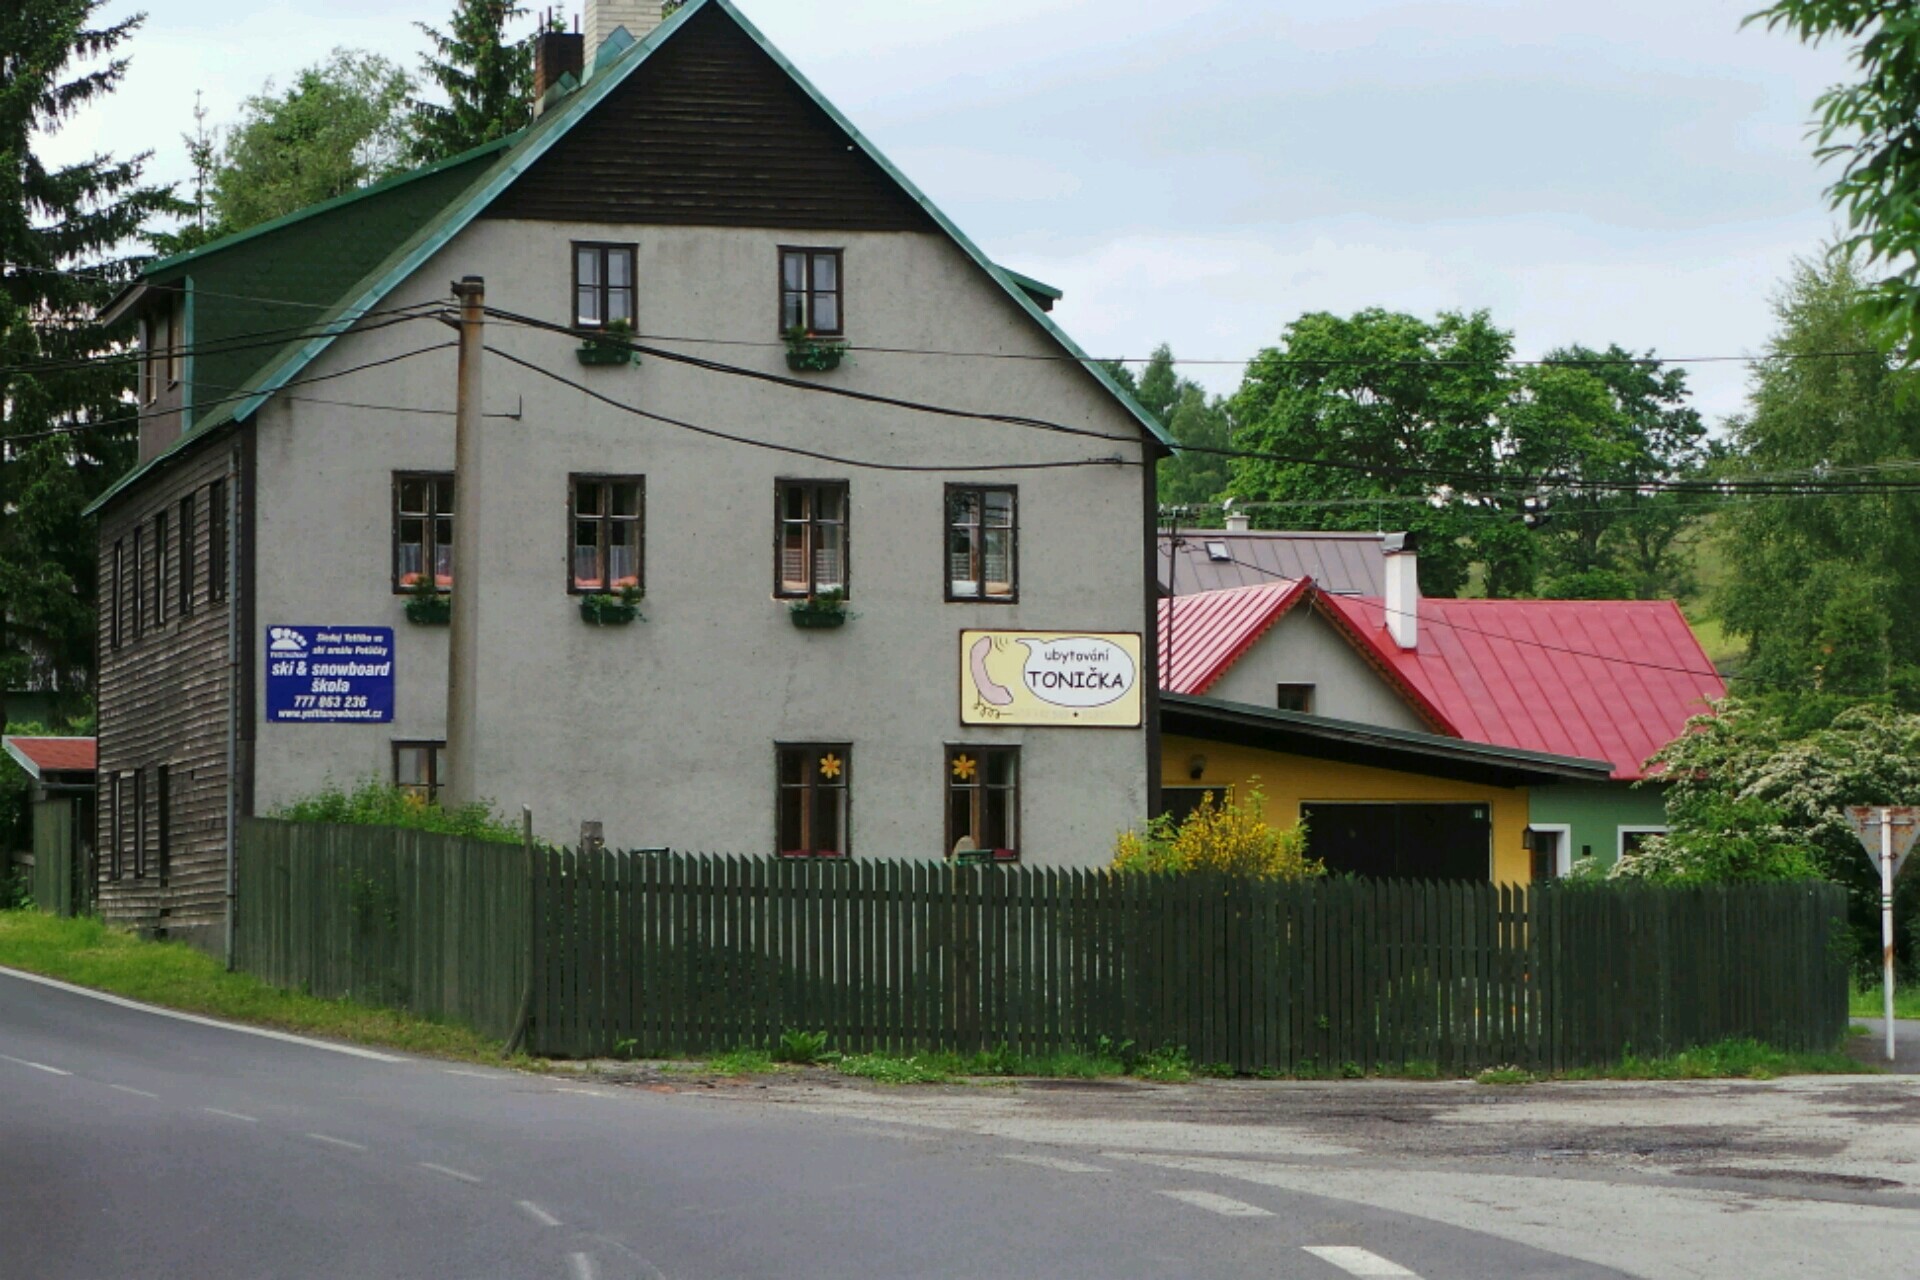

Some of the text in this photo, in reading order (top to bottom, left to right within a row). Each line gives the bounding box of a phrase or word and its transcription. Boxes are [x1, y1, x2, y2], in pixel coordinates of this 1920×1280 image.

[312, 646, 326, 654] ski
[1044, 648, 1109, 664] ubytování
[271, 661, 391, 676] ski & snowboard
[311, 678, 350, 692] škola
[1027, 667, 1124, 689] TONIČKA
[294, 695, 316, 708] 777
[343, 695, 368, 708] 236
